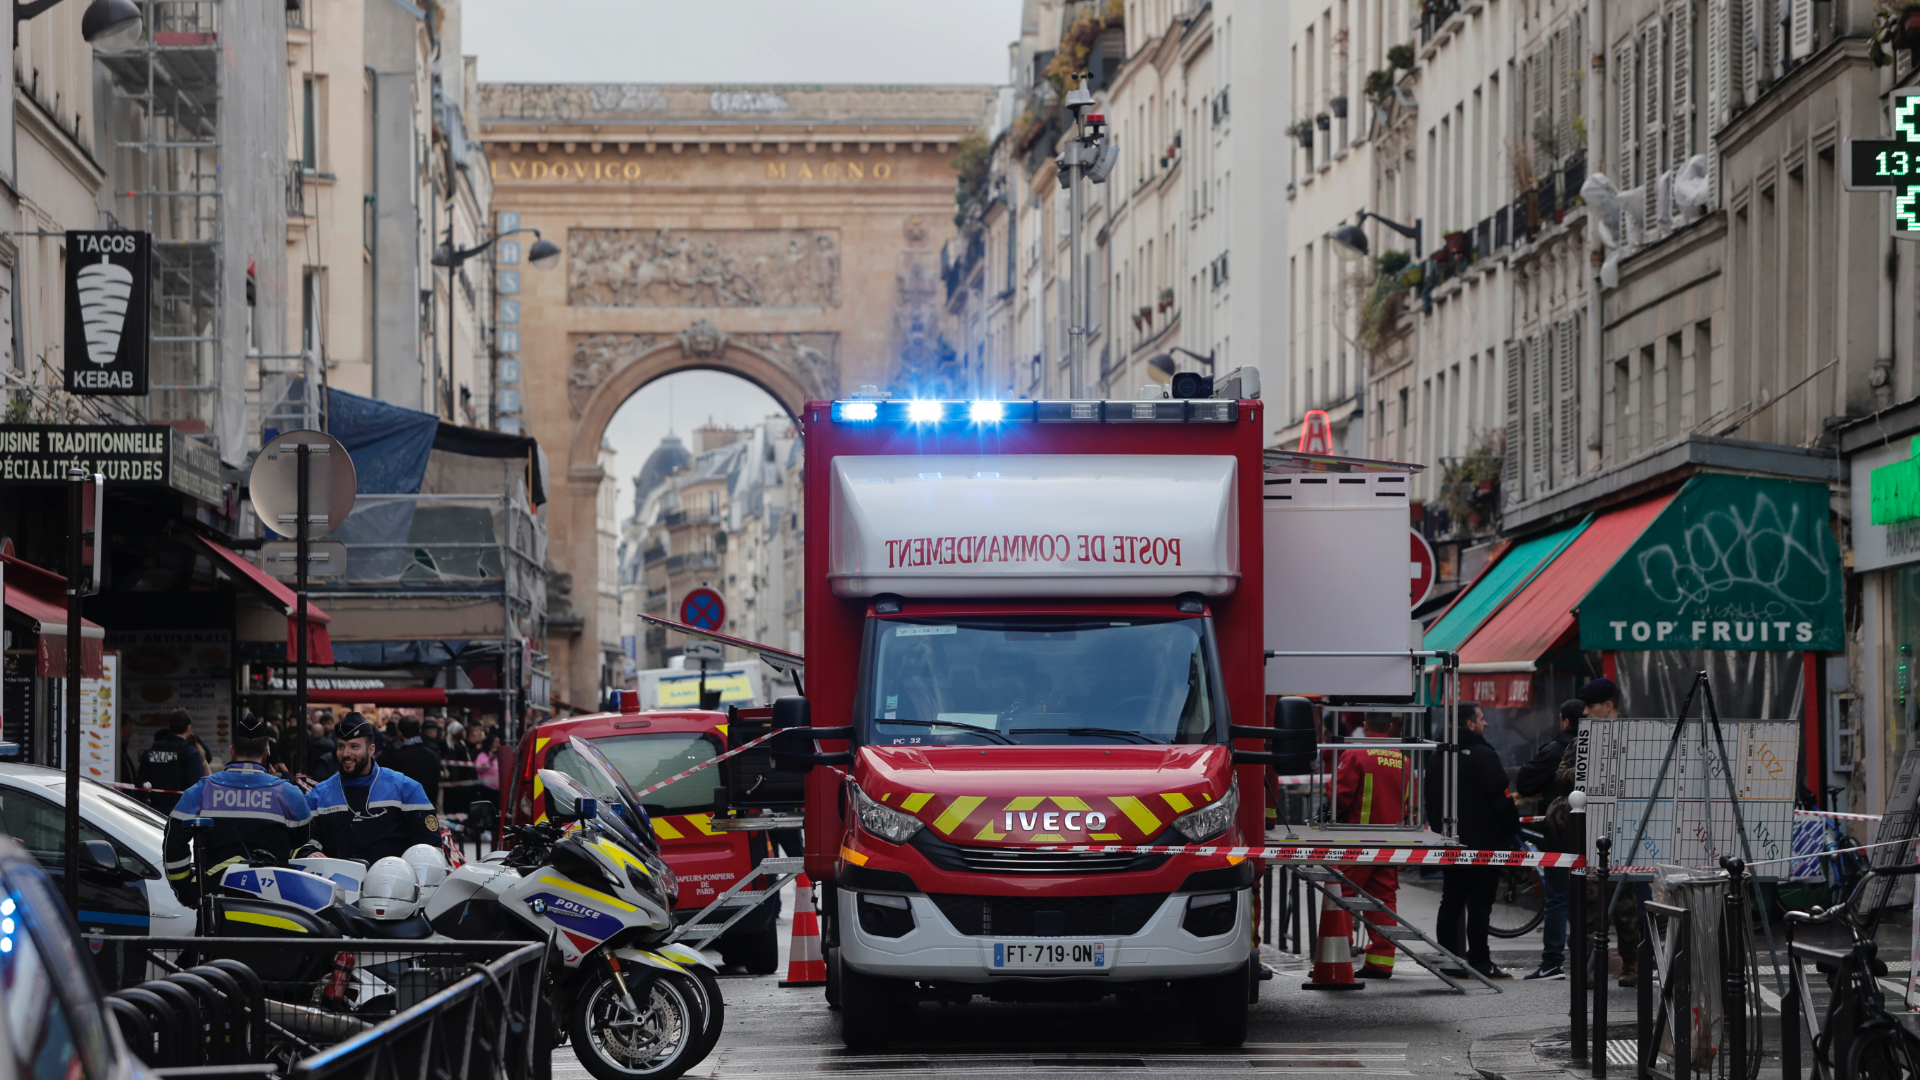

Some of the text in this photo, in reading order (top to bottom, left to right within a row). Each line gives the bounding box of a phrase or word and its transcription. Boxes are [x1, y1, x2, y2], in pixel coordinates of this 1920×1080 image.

[489, 160, 892, 181] LVDOVICO MAGNO
[77, 234, 136, 253] TACOS
[502, 213, 518, 411] PASSAGE
[73, 370, 134, 389] KEBAB
[48, 431, 163, 454] TRADITIONNELLE
[0, 455, 163, 481] ÉCIALITÉS KURDES
[1609, 620, 1671, 641] TOP
[1691, 620, 1814, 642] FRUITS
[892, 736, 922, 745] PC 32
[149, 750, 178, 763] POLICE
[1377, 756, 1403, 769] PARIS
[1576, 729, 1590, 782] MOYENS
[213, 789, 273, 809] POLICE
[1004, 811, 1108, 832] IVECO
[260, 877, 275, 888] 17
[696, 887, 715, 896] PARIS
[555, 898, 601, 920] POLICE
[1006, 944, 1093, 964] FT-719-QN
[1095, 953, 1104, 963] 75
